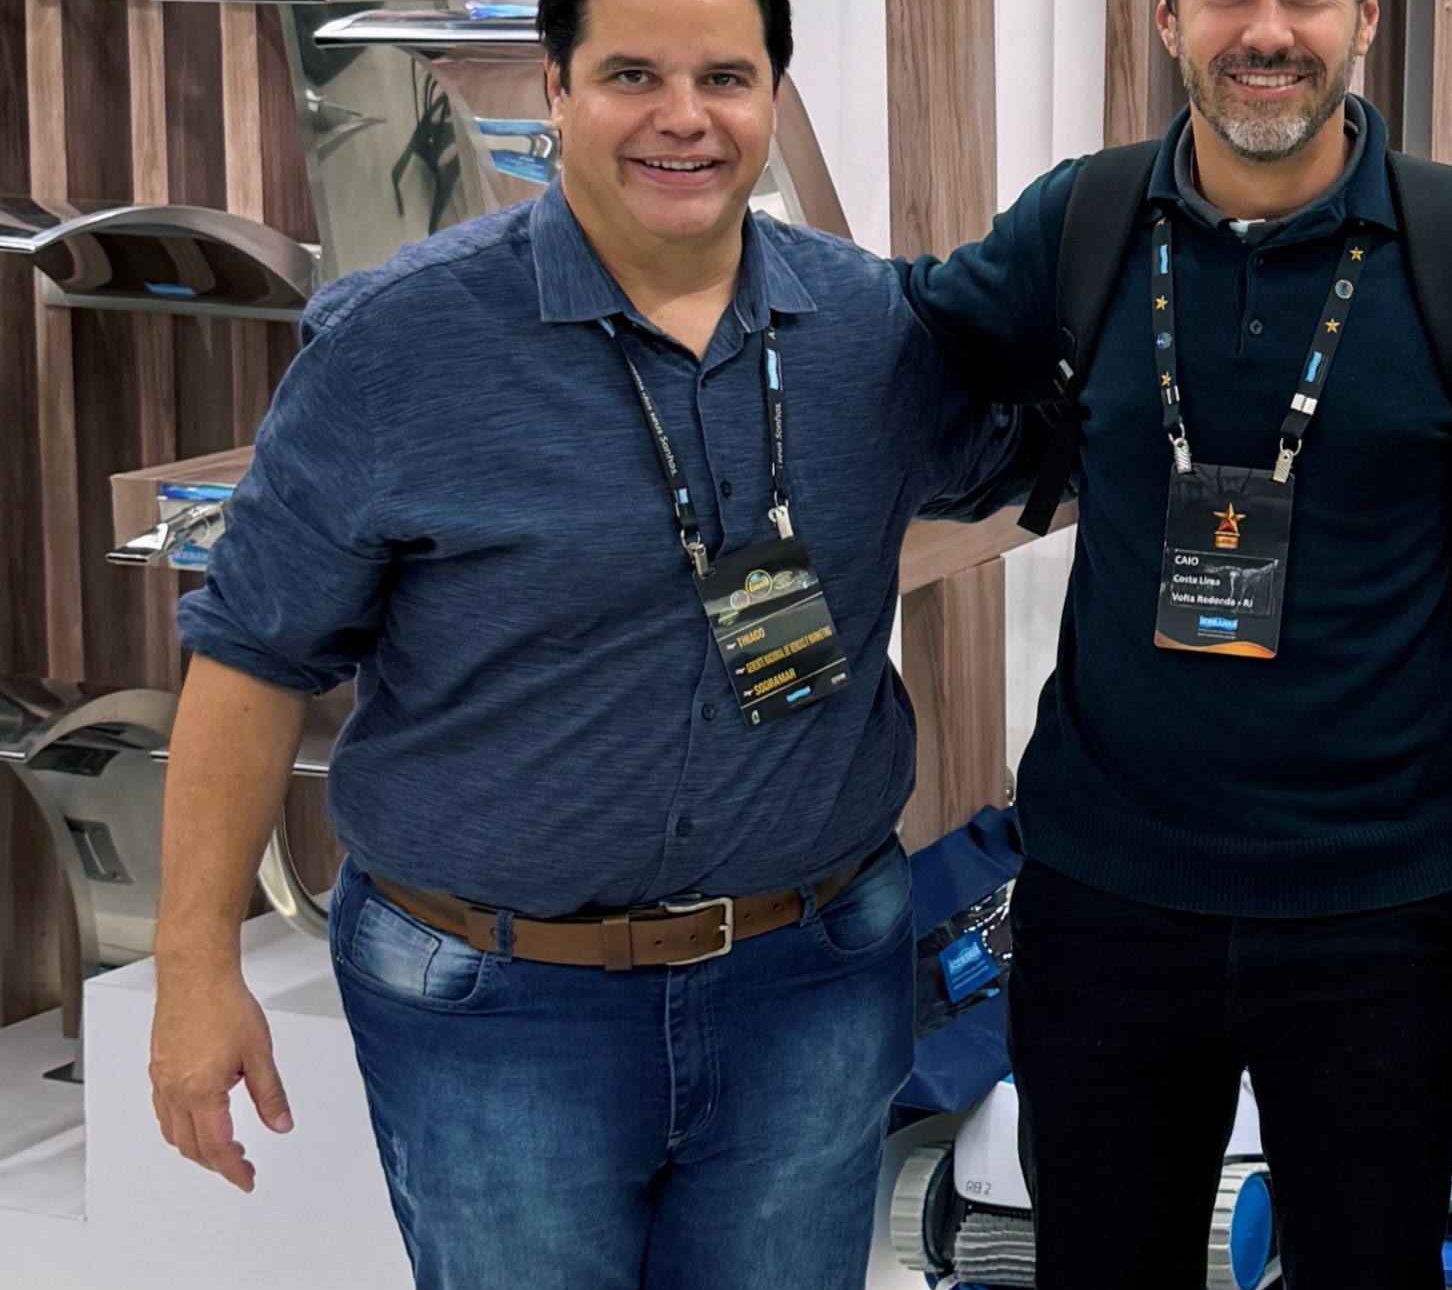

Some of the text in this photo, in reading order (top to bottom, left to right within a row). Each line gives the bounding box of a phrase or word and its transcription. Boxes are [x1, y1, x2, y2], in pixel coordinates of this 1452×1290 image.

[1174, 554, 1200, 566] CAIO
[1172, 573, 1221, 586] Costa Lima
[1171, 591, 1196, 603] Volta
[1197, 594, 1236, 607] Redonda
[736, 626, 766, 649] THIAGO
[753, 667, 797, 696] SODRAMAR
